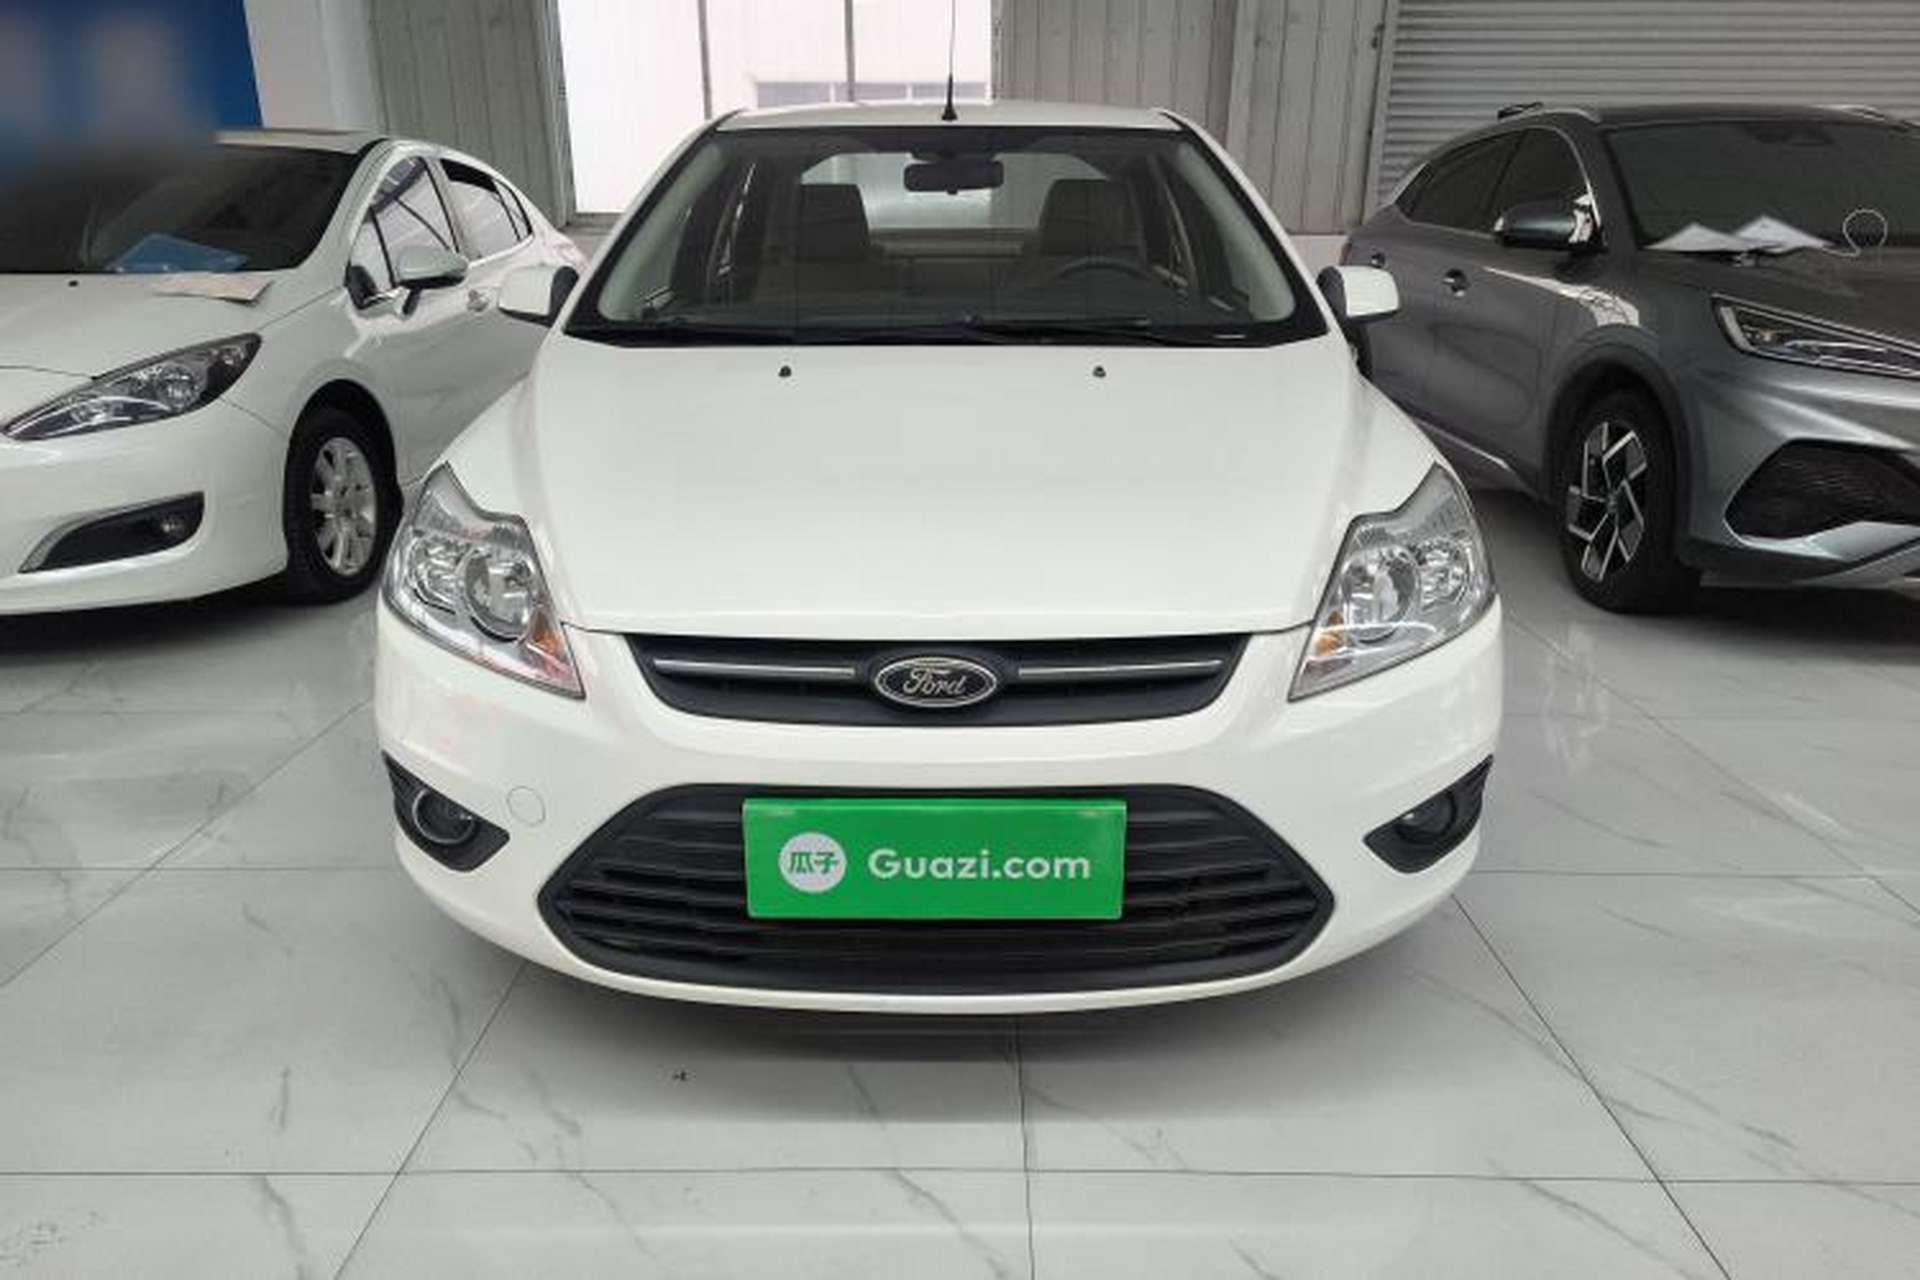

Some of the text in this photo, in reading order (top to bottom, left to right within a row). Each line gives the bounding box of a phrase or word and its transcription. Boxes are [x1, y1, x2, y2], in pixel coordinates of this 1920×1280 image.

[902, 666, 967, 695] Ford
[788, 851, 840, 875] 瓜子
[867, 847, 1091, 879] Guazi.com
